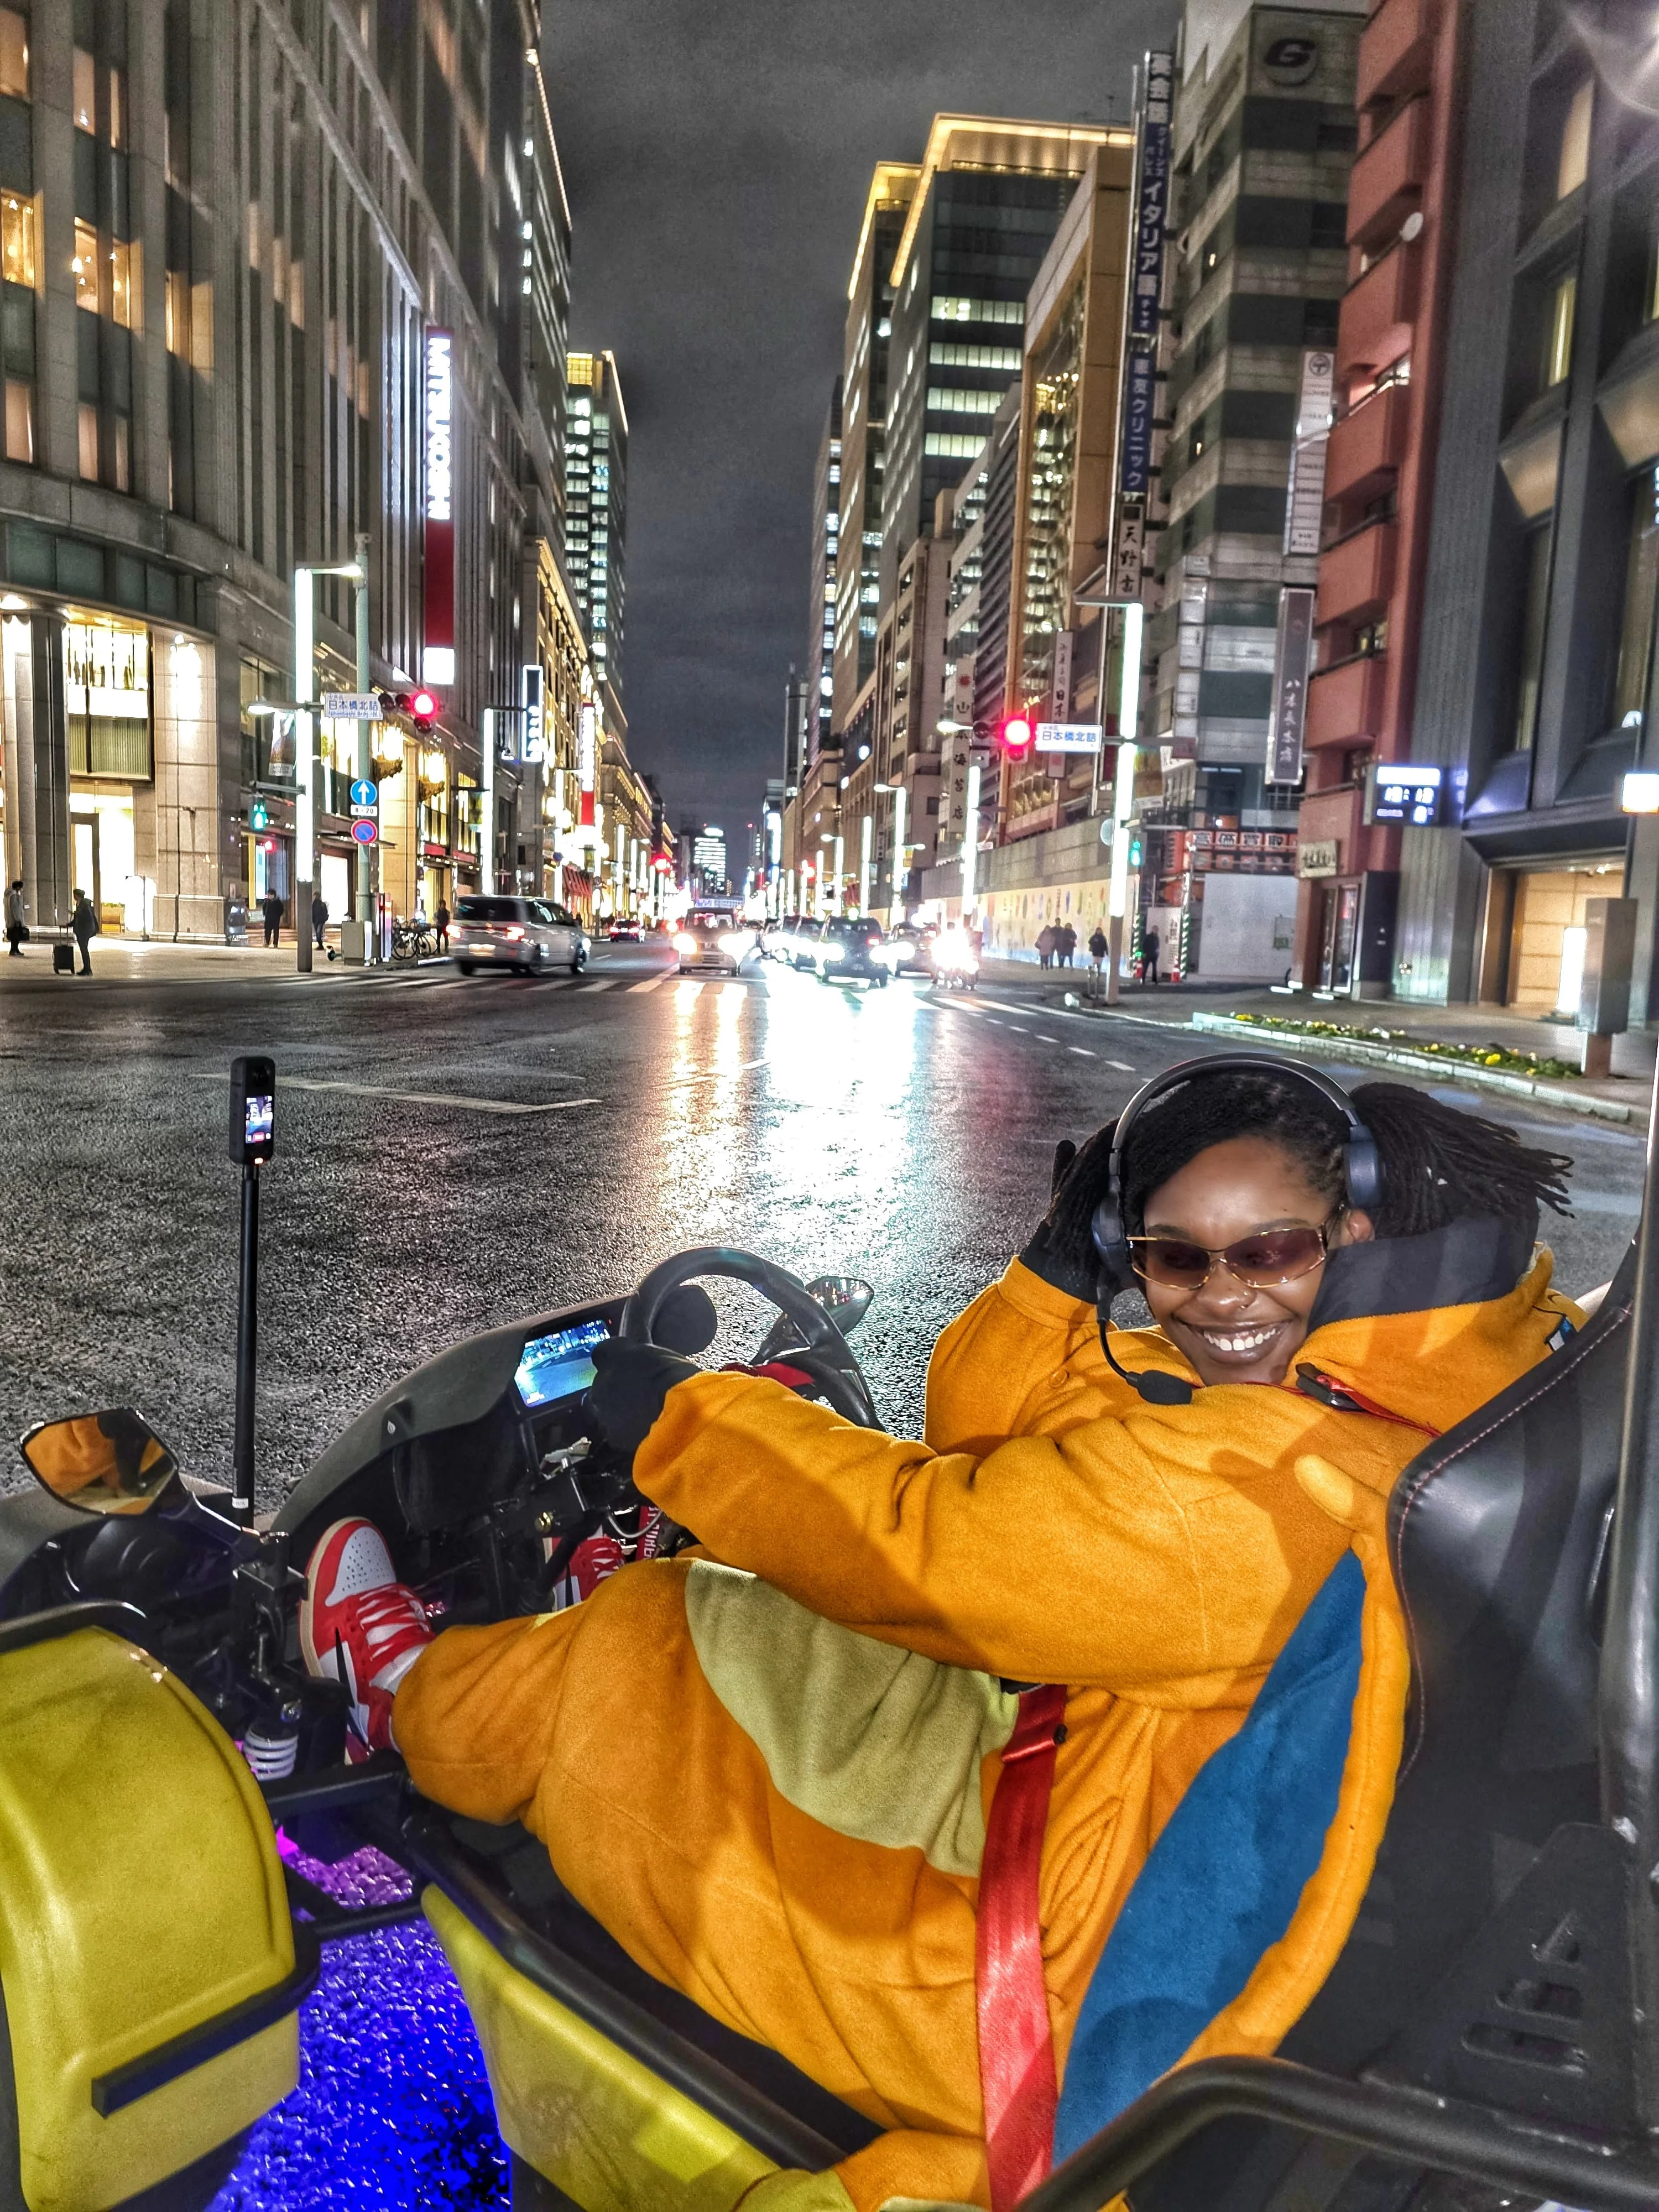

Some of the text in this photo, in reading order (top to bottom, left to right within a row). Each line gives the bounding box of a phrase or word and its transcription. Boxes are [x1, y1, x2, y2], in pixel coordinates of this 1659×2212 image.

[328, 700, 378, 711] 日本橋北詰
[1042, 731, 1097, 742] 日本橋北詰
